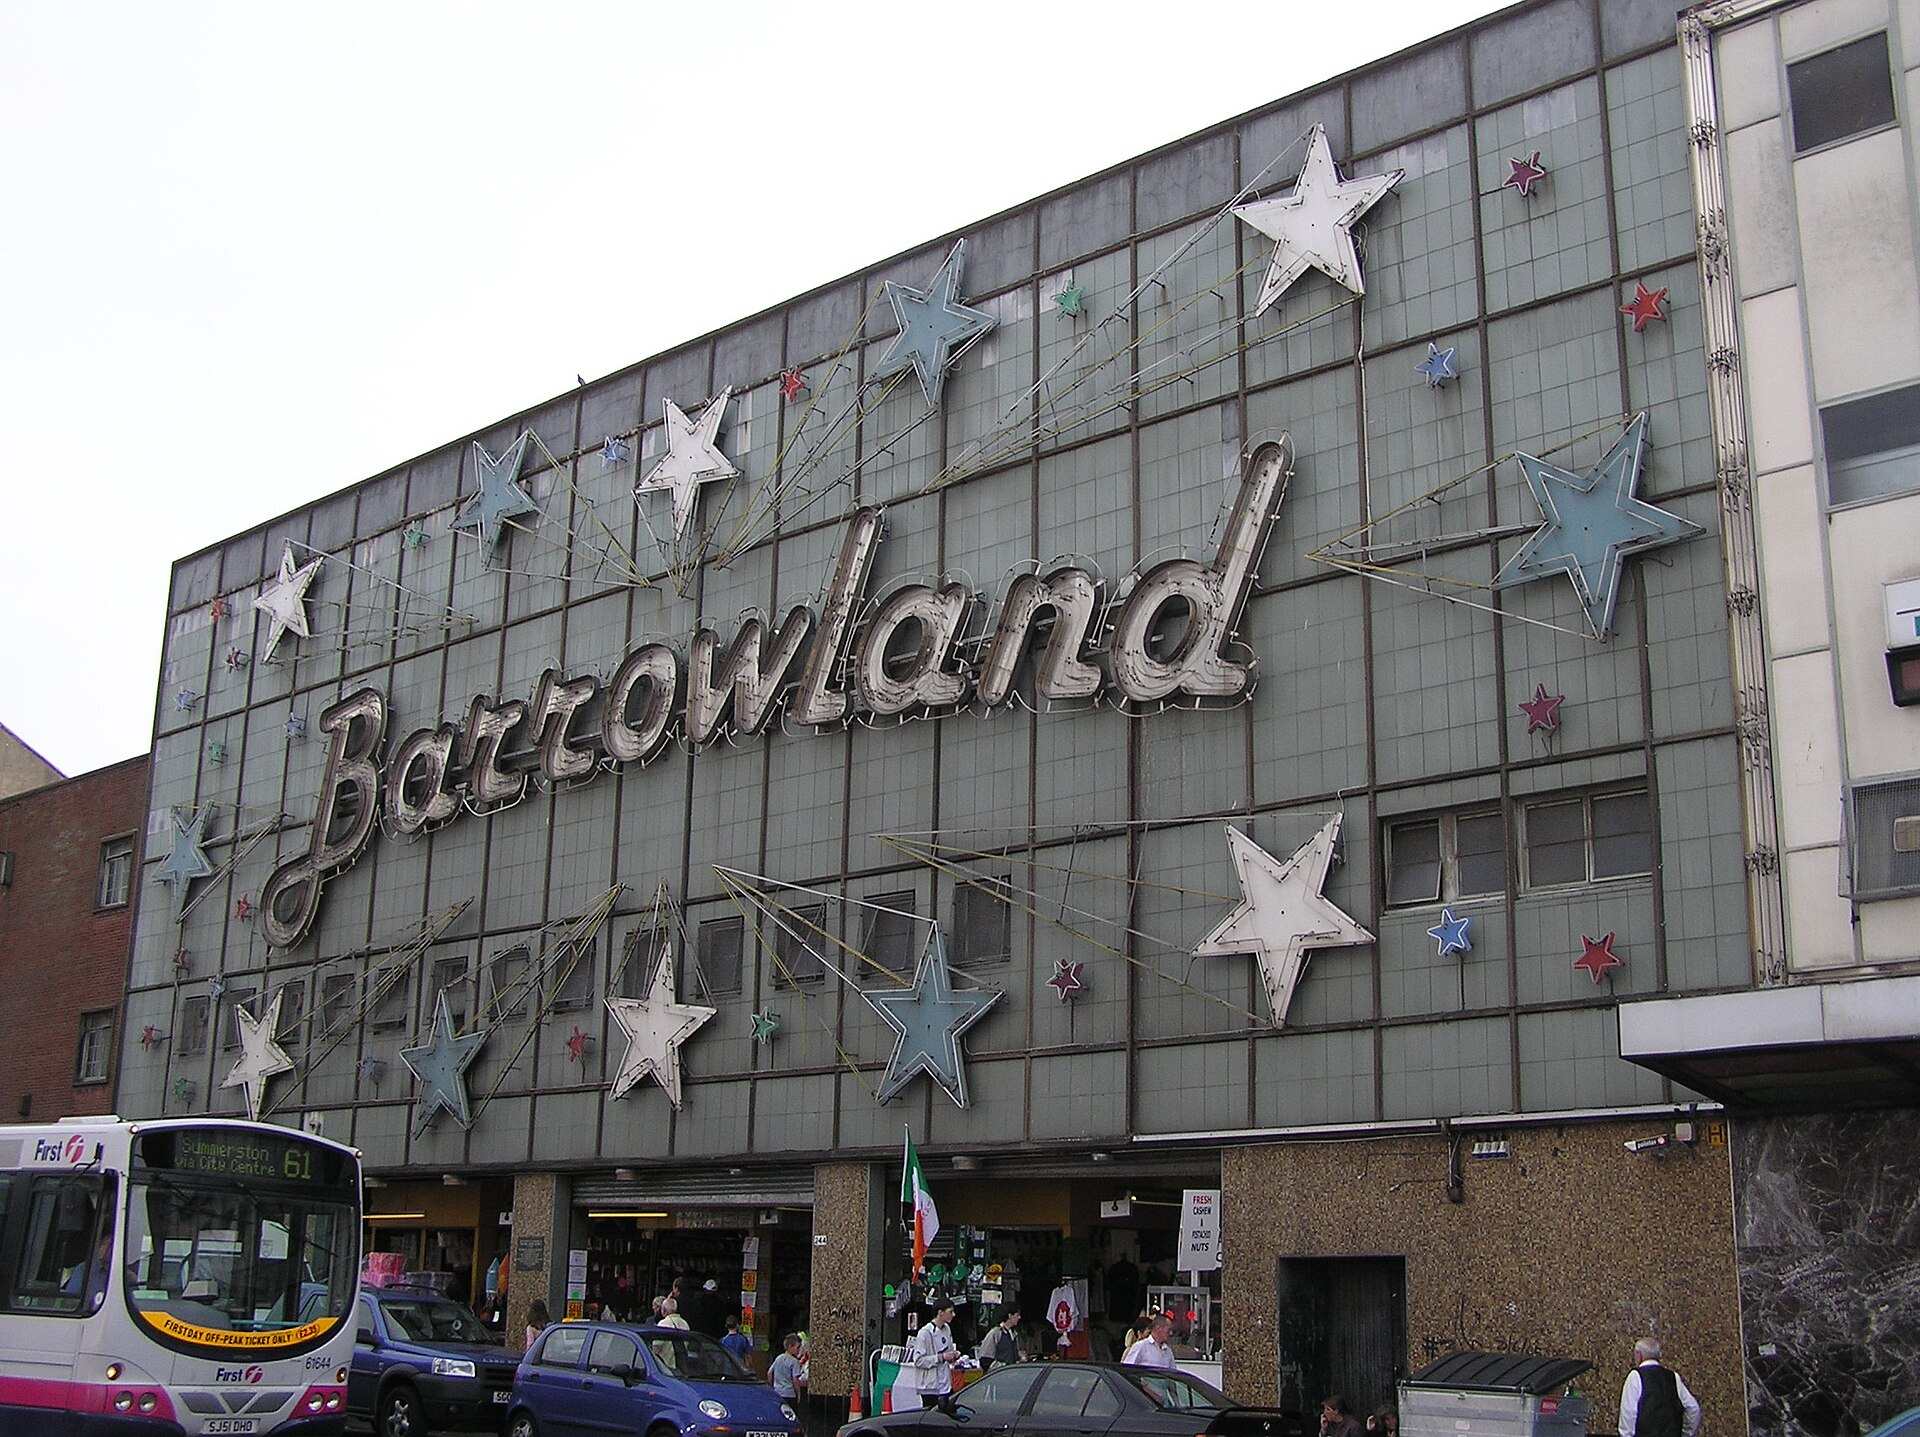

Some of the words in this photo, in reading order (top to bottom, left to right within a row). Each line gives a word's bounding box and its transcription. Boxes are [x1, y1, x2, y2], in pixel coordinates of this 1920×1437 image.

[264, 438, 1293, 948] Barrowland
[34, 1139, 63, 1161] First
[183, 1138, 269, 1161] Summerston
[200, 1155, 226, 1171] City
[231, 1158, 276, 1175] Centre
[284, 1149, 311, 1179] 61
[1193, 1195, 1212, 1204] FRESH
[1191, 1243, 1209, 1252] NUTS
[205, 1333, 243, 1345] OFF-PEAK
[245, 1335, 270, 1345] TICKET
[305, 1357, 331, 1370] 61644
[215, 1367, 243, 1382] First
[209, 1420, 231, 1432] SJ51
